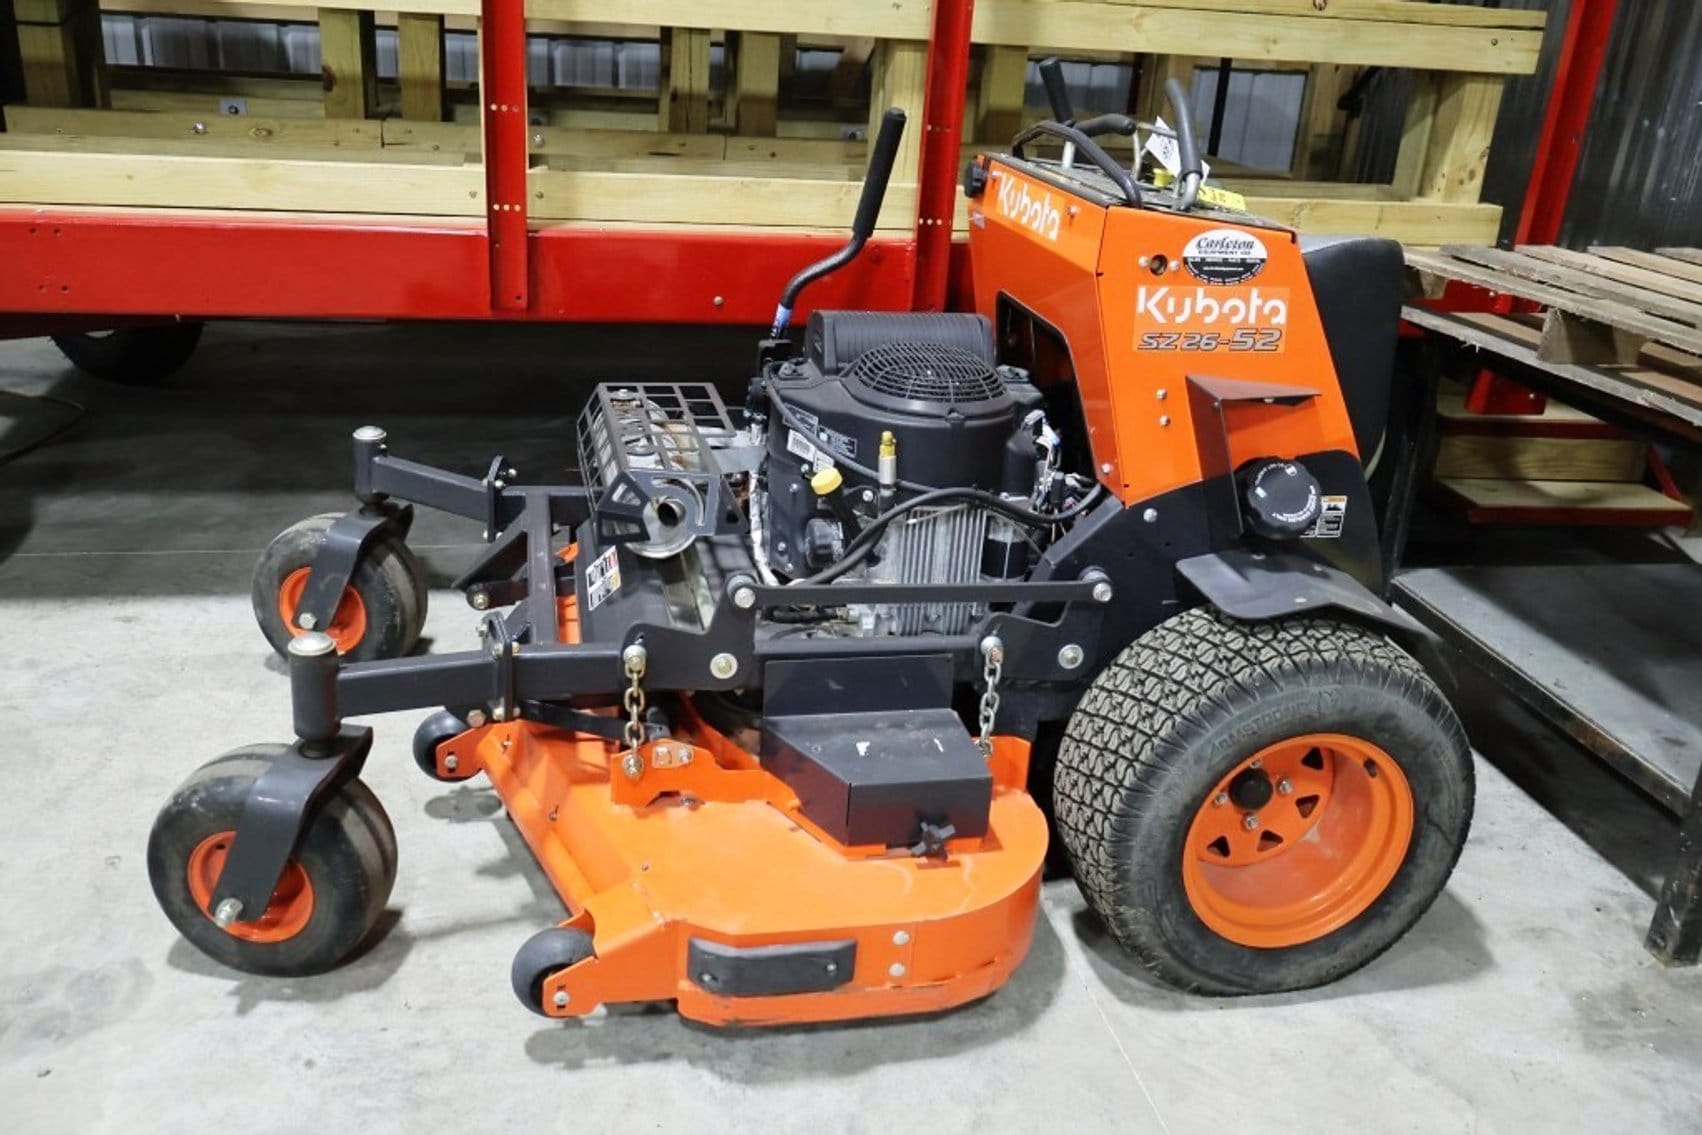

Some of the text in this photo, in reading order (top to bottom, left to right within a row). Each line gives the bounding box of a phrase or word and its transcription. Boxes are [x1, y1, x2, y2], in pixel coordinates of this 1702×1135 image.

[999, 172, 1059, 241] Kubota
[1196, 236, 1255, 250] Carleton
[1137, 287, 1286, 324] Kubota
